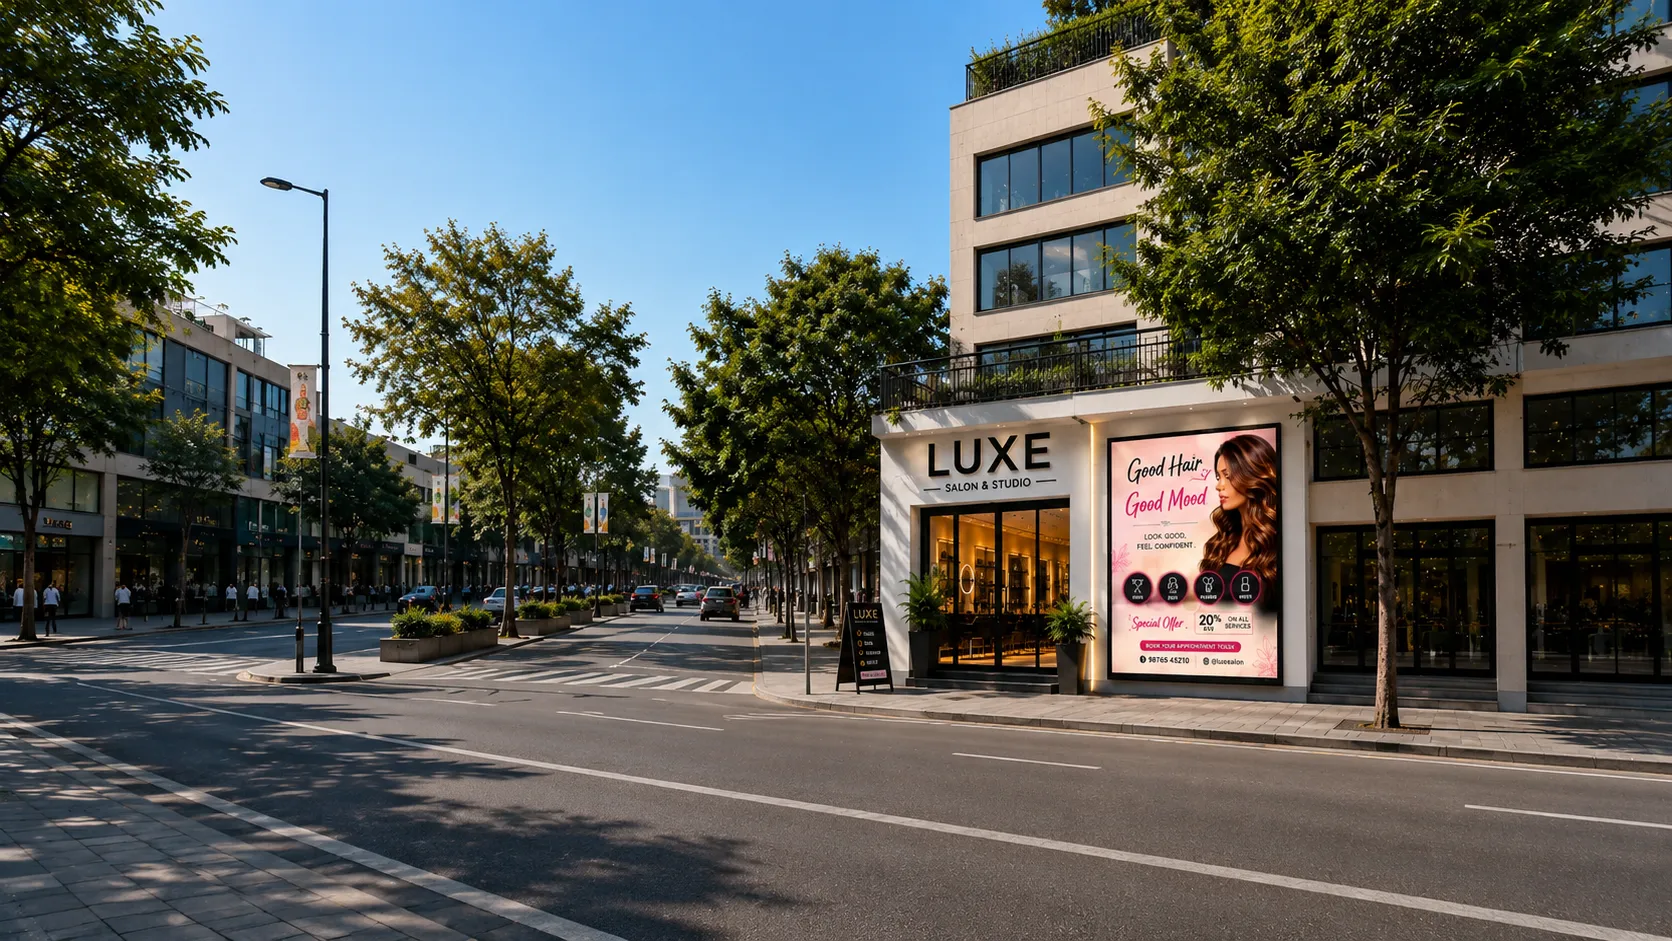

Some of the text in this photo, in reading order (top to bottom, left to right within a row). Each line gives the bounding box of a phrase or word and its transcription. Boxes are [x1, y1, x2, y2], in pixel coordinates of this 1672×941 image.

[928, 431, 1051, 477] LUXE
[1127, 453, 1203, 484] Good Hair
[945, 478, 1032, 493] SALON & STUDIO
[1125, 486, 1208, 518] Good Mood
[853, 609, 879, 619] LUXE
[1199, 614, 1222, 626] 20%
[1131, 615, 1184, 631] Special Offer
